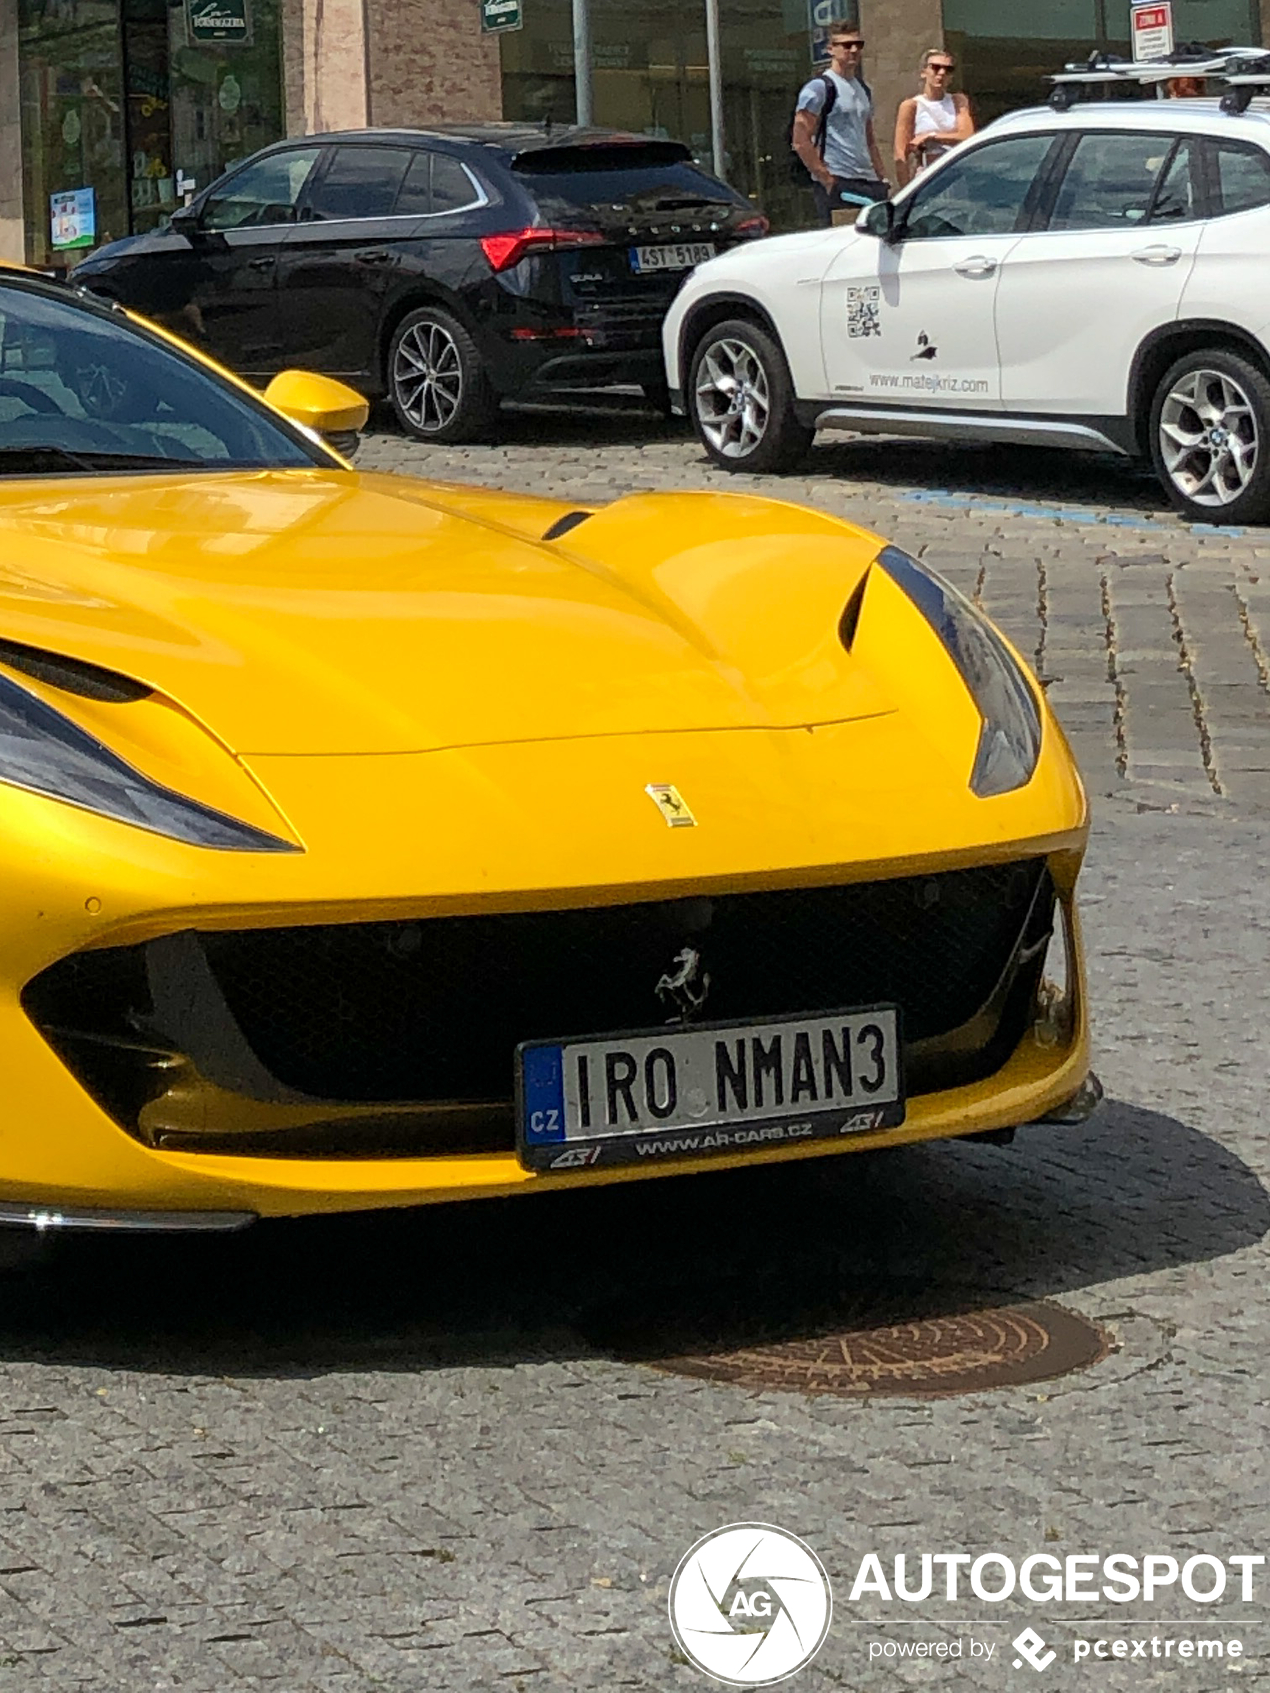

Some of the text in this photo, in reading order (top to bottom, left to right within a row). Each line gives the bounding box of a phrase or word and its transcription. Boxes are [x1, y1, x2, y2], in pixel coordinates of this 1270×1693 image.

[641, 245, 710, 266] 4ST 5189
[869, 374, 989, 393] www.matejkriz.com
[715, 1023, 885, 1113] NMAN3
[531, 1110, 559, 1132] CZ
